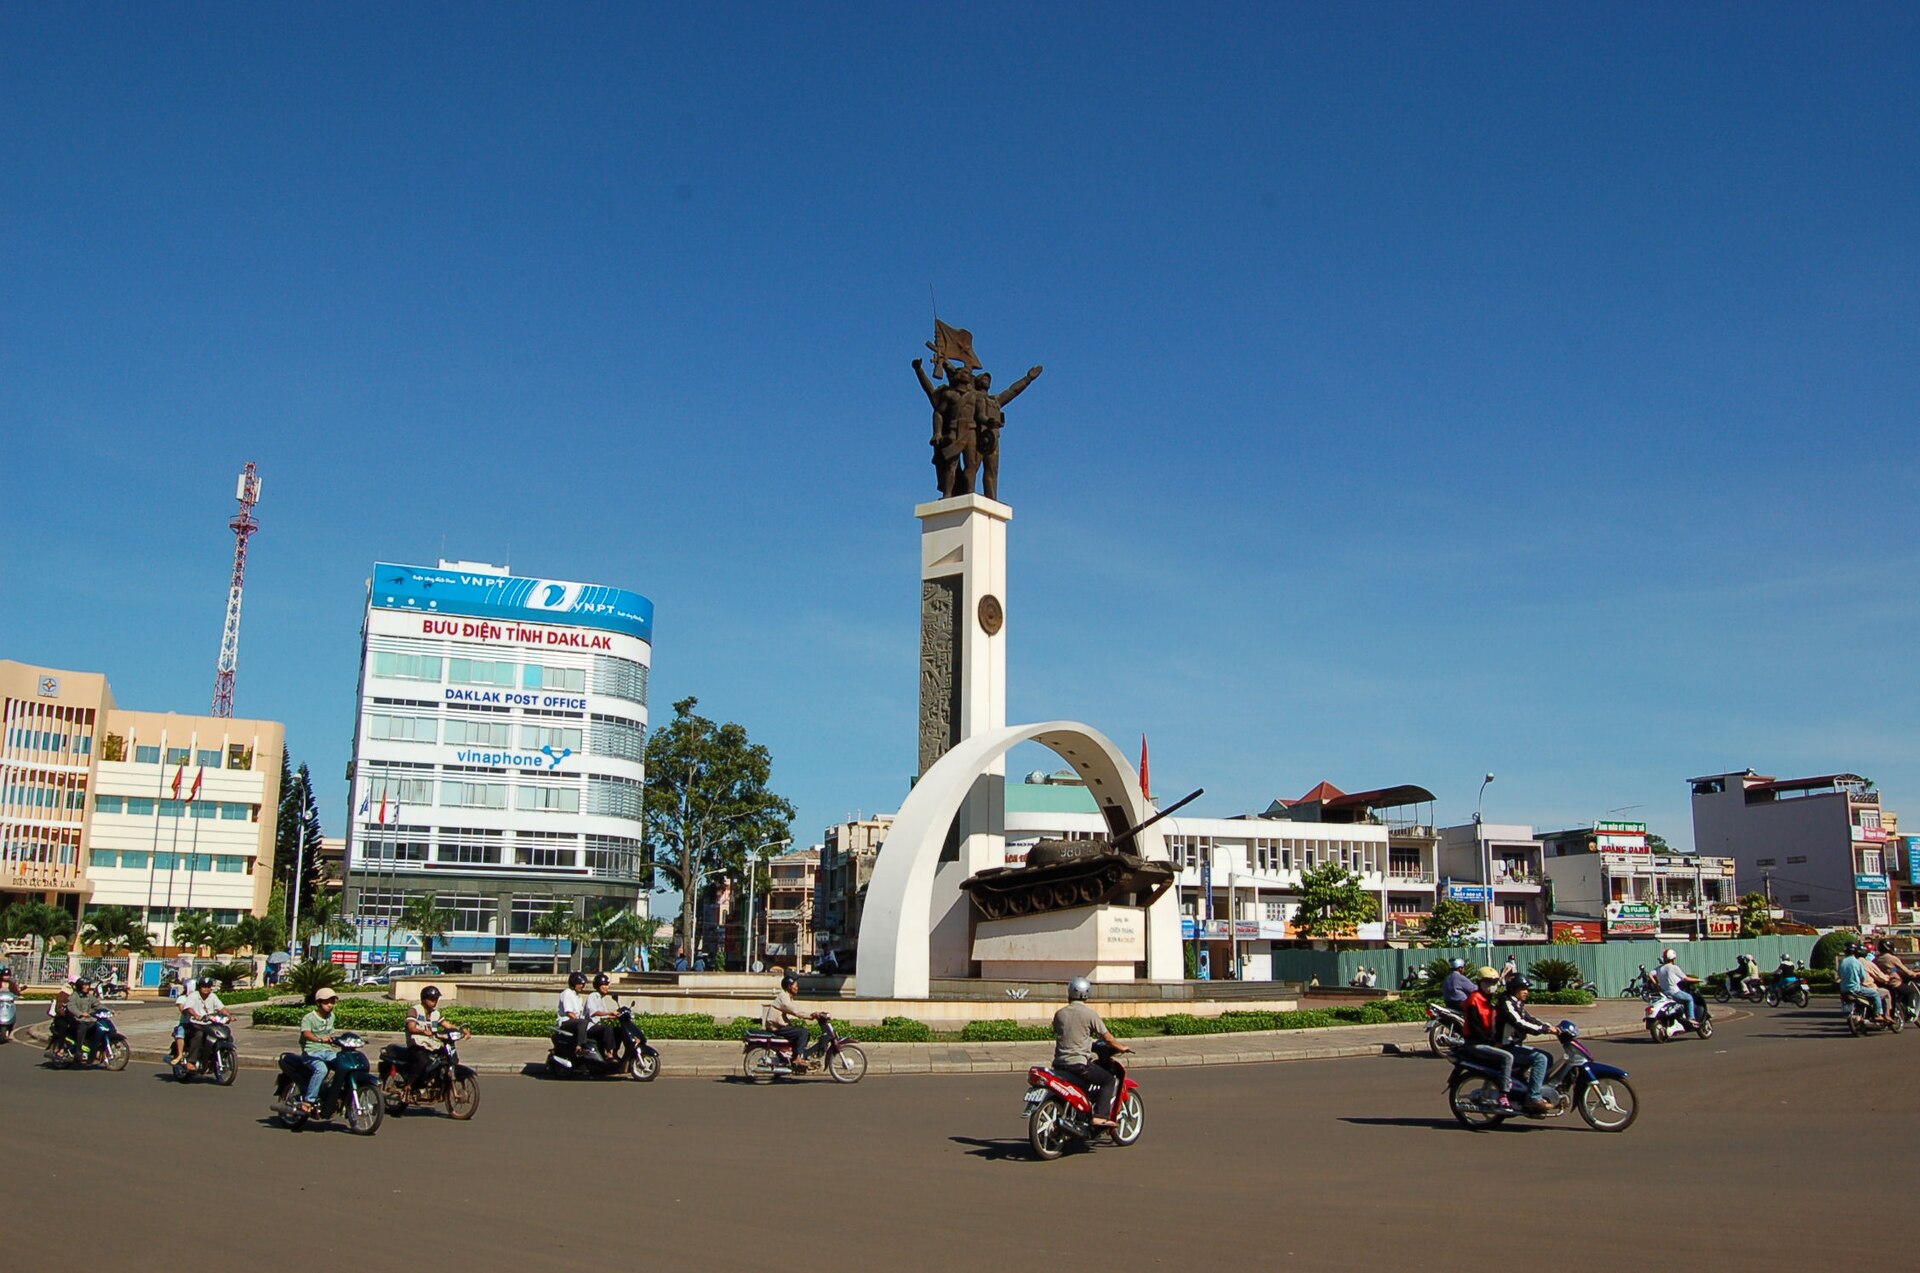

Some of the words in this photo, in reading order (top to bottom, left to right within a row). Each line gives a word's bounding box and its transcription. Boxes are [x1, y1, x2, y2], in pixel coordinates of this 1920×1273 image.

[460, 575, 506, 588] VNPT
[574, 602, 615, 614] VNPT
[422, 619, 459, 635] BƯU
[462, 621, 502, 643] ĐIỆN
[506, 622, 543, 644] TỈNH
[546, 630, 612, 650] DAKLAK
[445, 688, 501, 704] DAKLAK
[505, 693, 539, 706] POST
[543, 696, 587, 710] OFFICE
[457, 750, 543, 767] vinaphone
